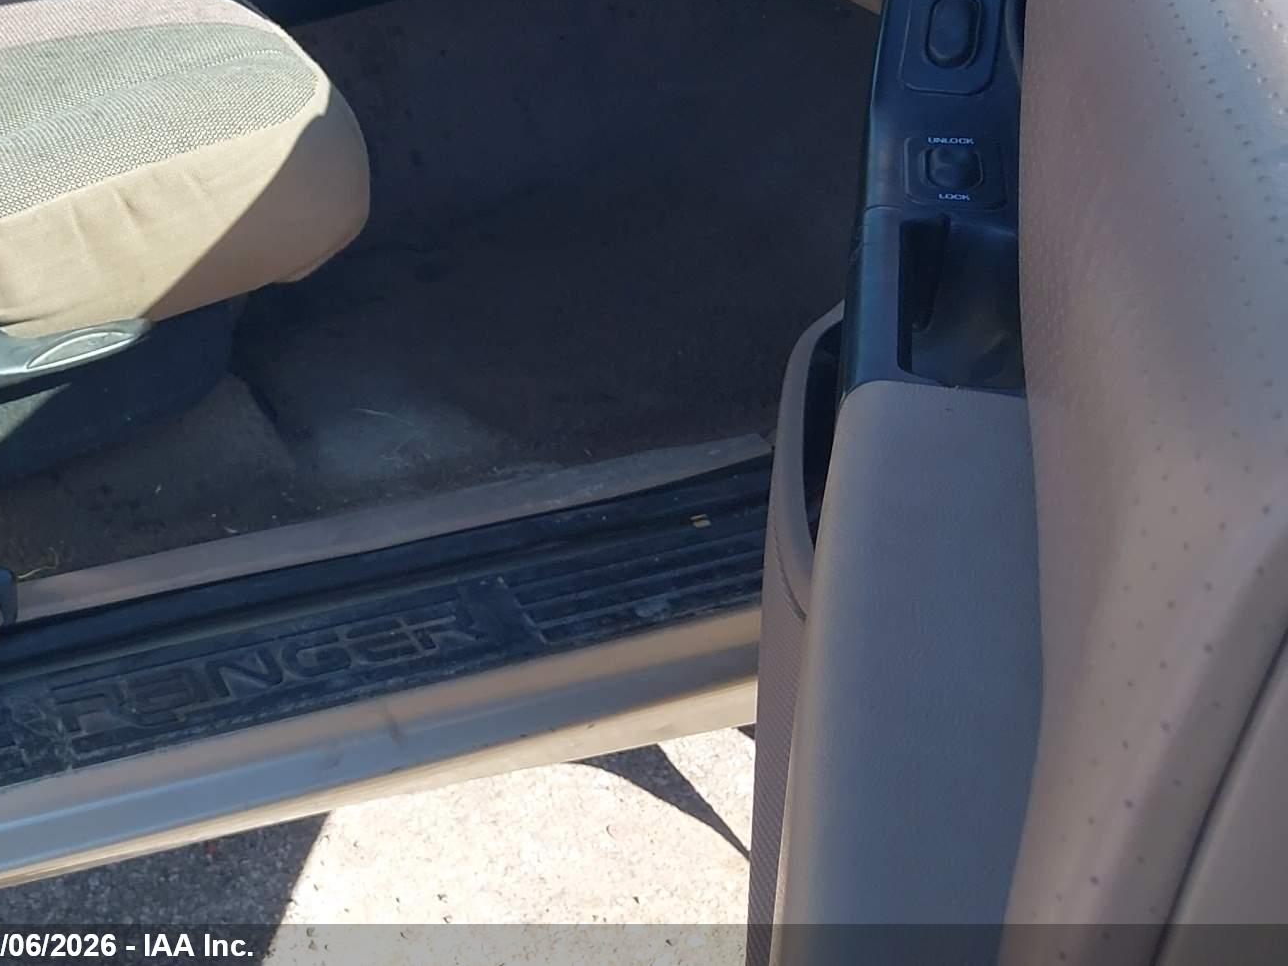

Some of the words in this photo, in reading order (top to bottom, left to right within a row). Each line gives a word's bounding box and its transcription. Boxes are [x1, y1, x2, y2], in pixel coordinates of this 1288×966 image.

[927, 136, 974, 144] UNLOCK
[939, 192, 970, 200] LOCK
[57, 611, 479, 737] RANGER
